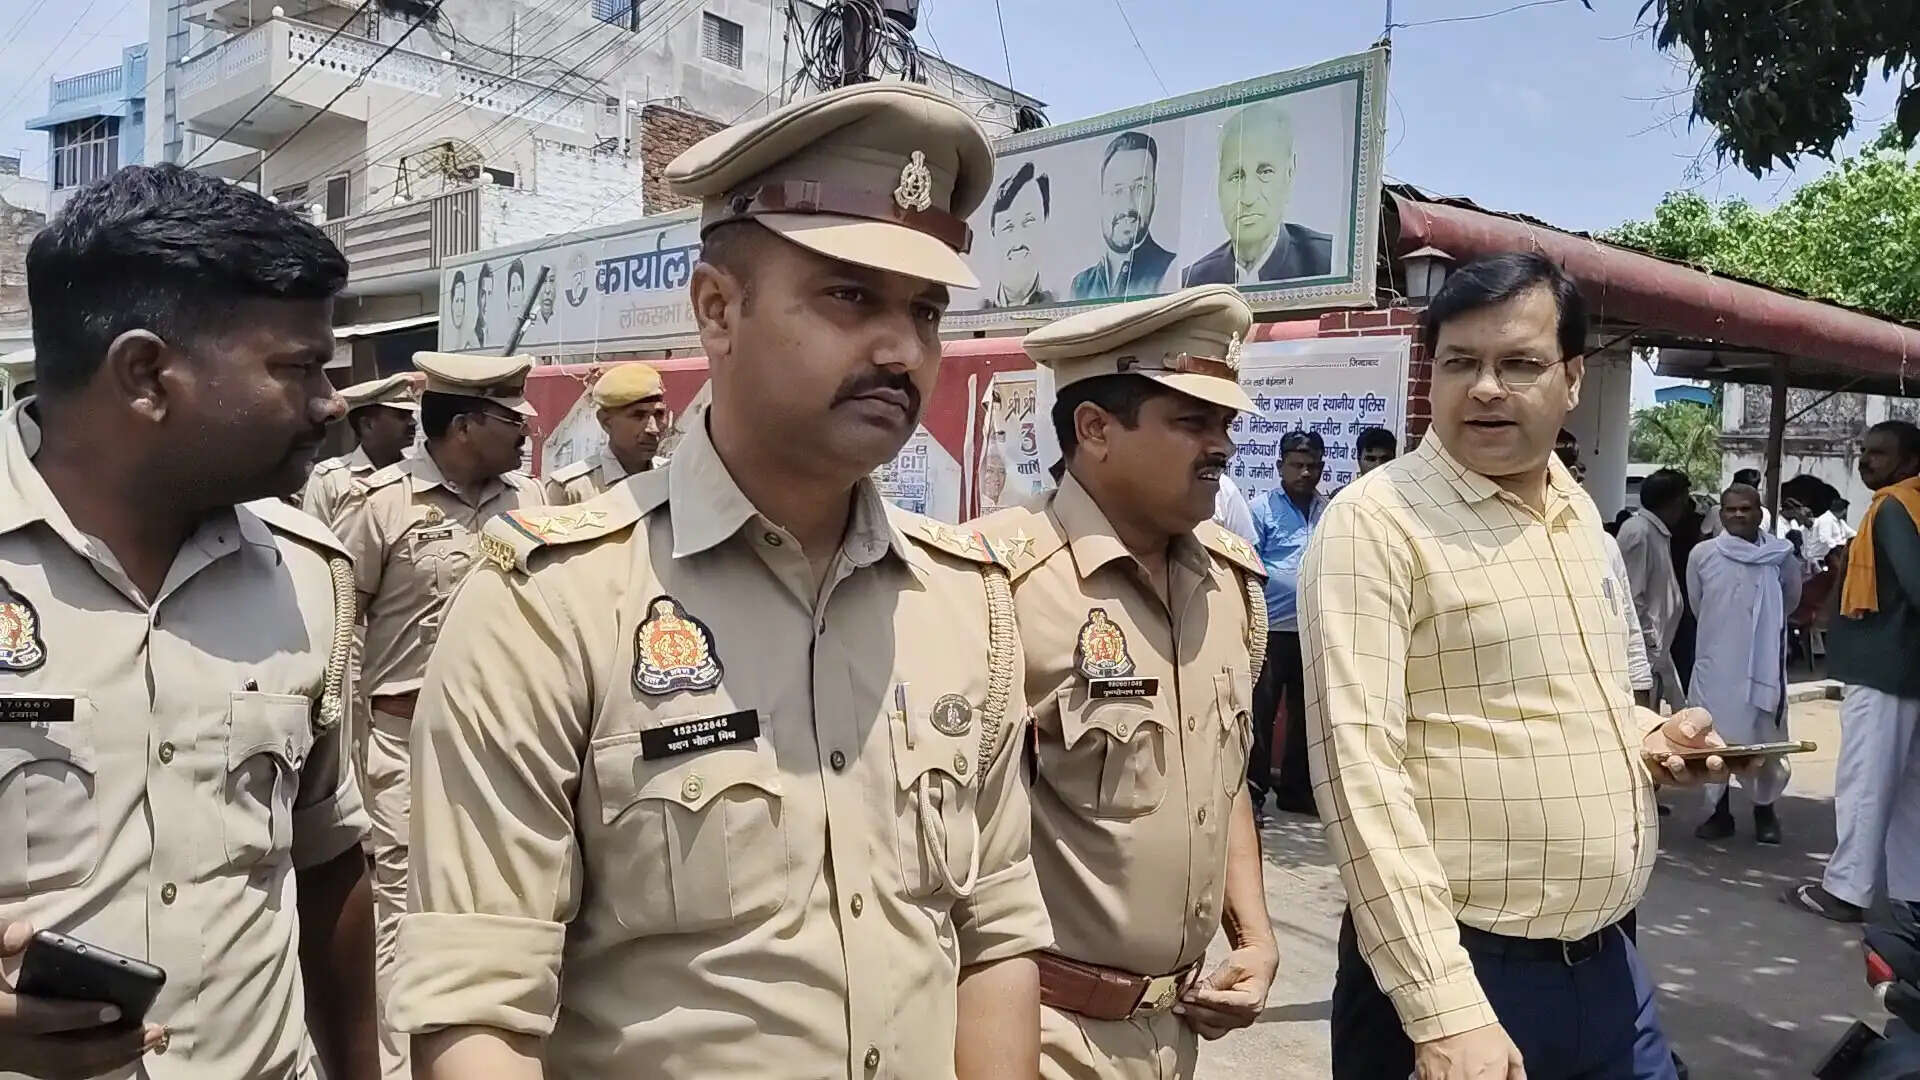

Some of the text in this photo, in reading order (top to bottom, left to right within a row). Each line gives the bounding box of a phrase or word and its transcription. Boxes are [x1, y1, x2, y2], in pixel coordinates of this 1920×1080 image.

[1274, 397, 1304, 413] प्रशासन
[1307, 394, 1322, 412] एवं
[1323, 393, 1355, 412] स्थानीय
[1358, 392, 1386, 418] पुलिस
[1232, 418, 1243, 433] की
[1294, 417, 1303, 432] से
[1235, 460, 1245, 478] की
[1323, 464, 1332, 482] के
